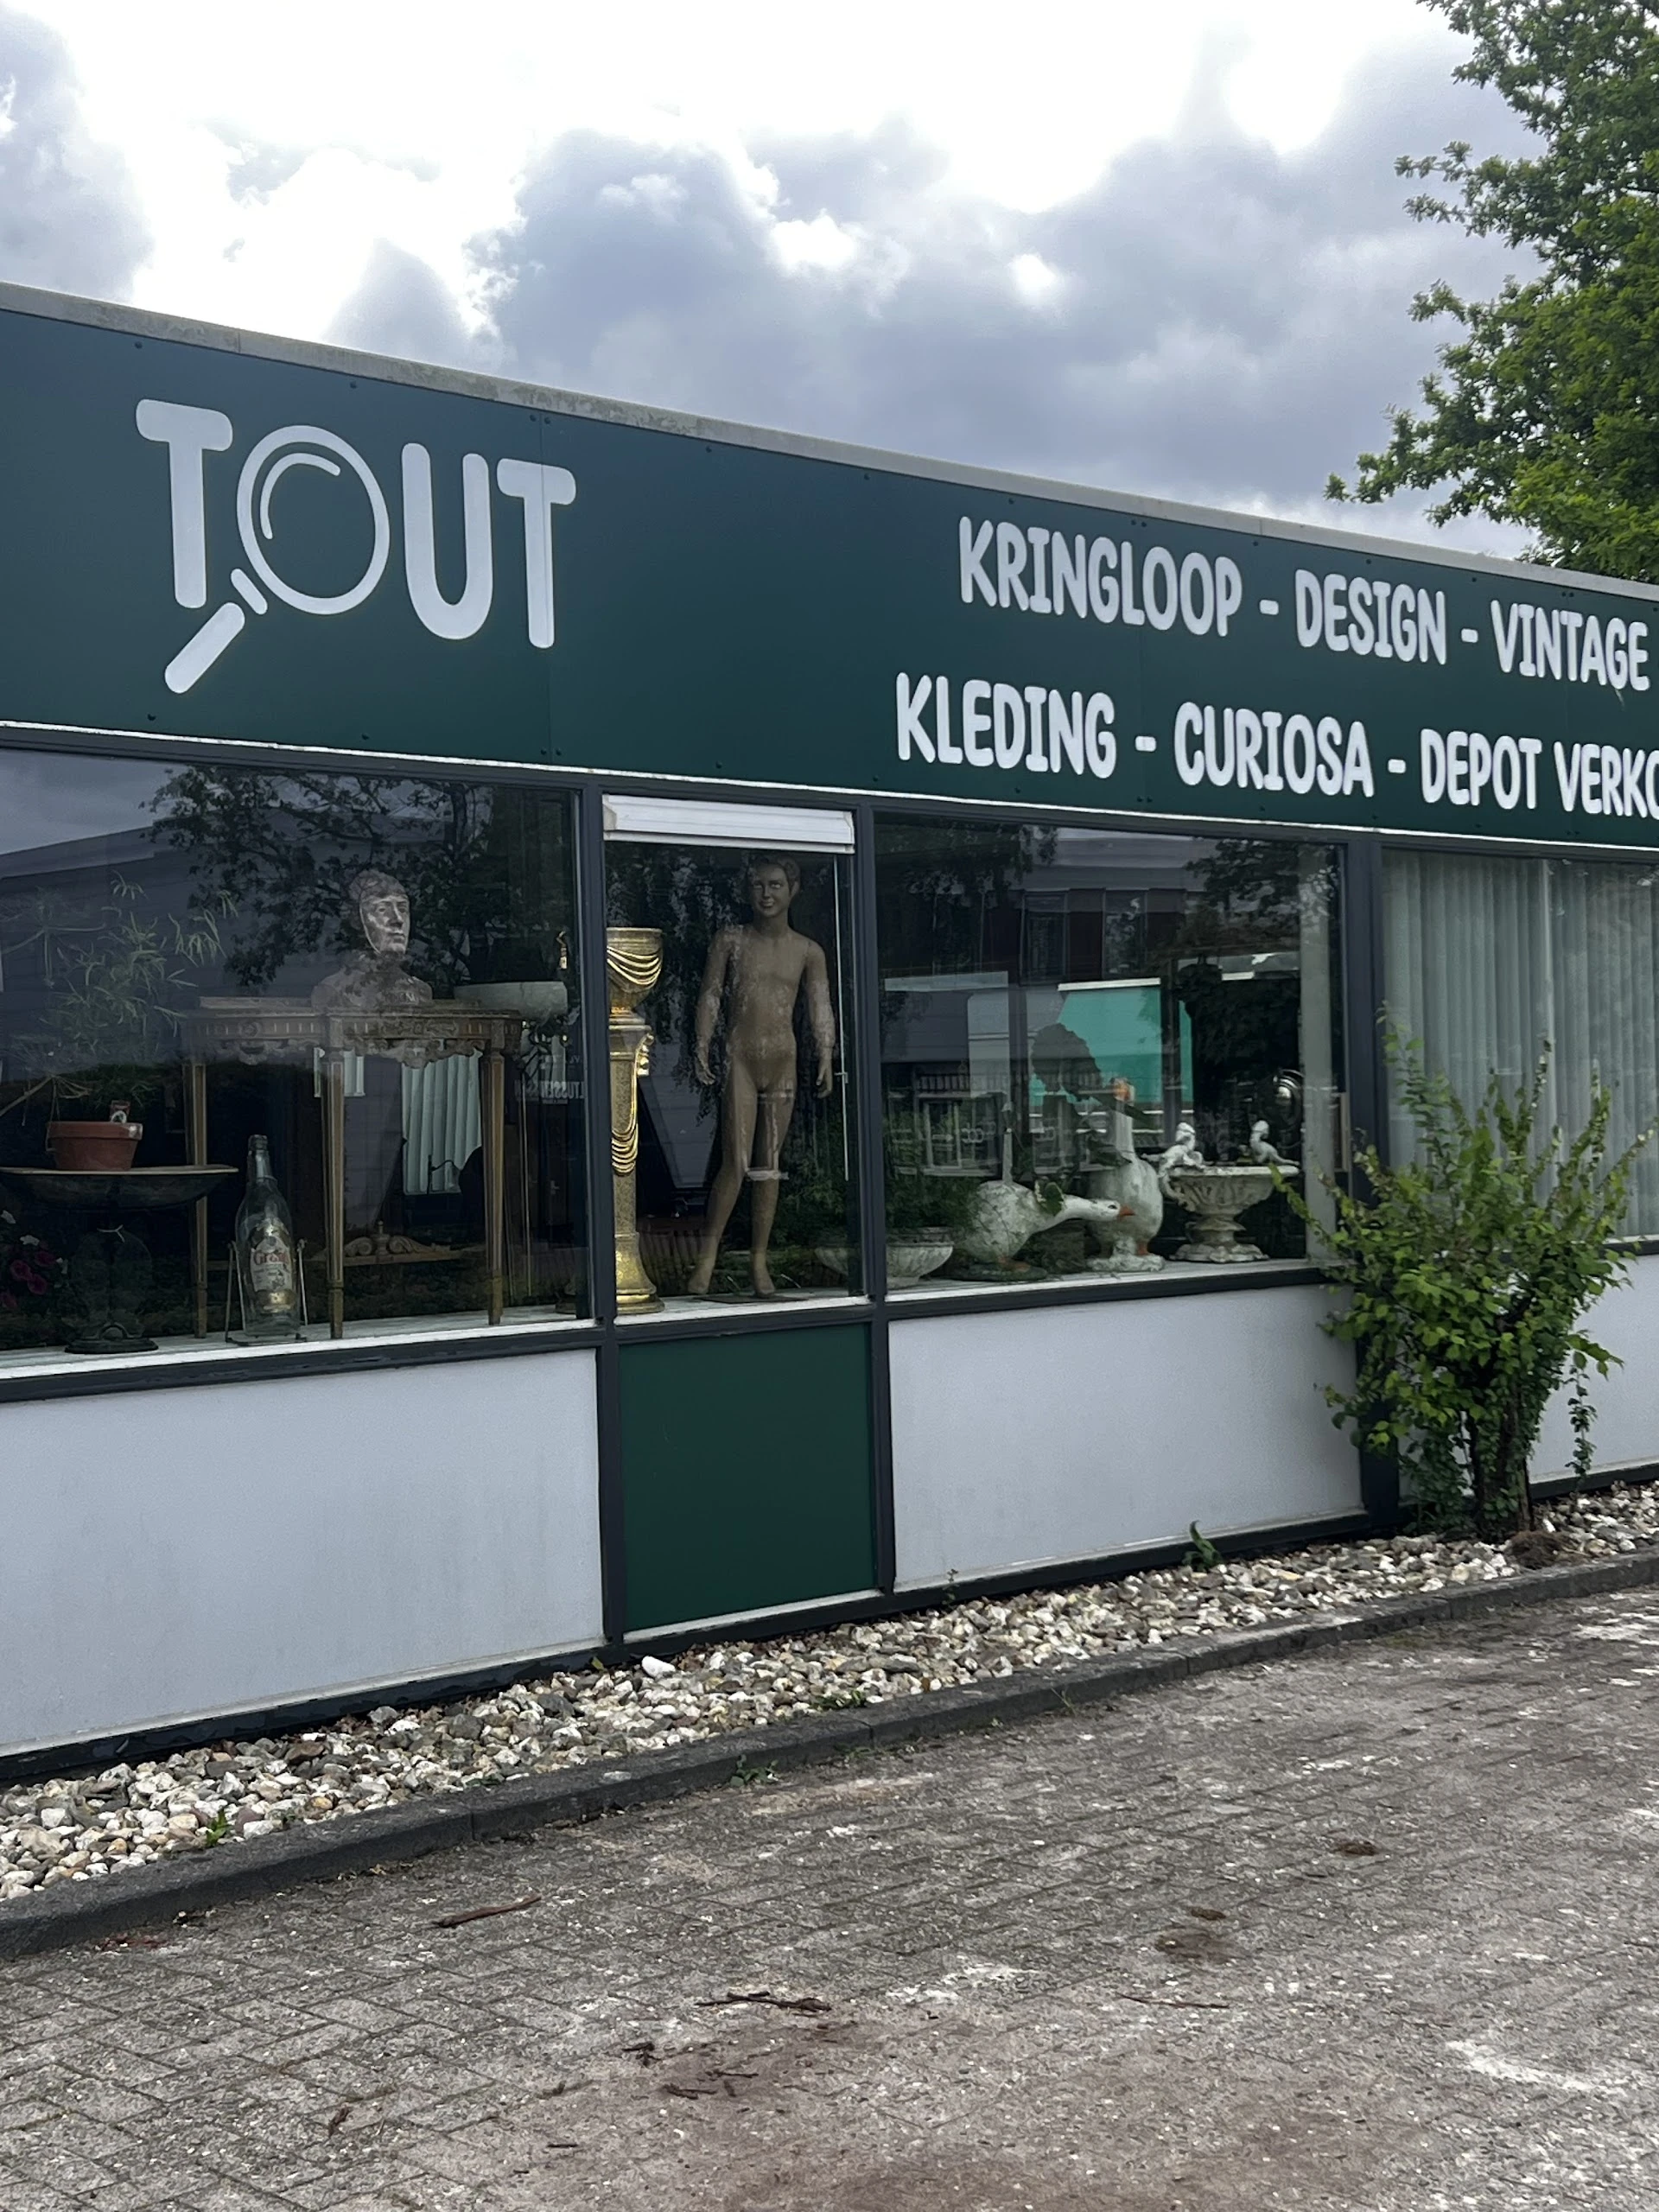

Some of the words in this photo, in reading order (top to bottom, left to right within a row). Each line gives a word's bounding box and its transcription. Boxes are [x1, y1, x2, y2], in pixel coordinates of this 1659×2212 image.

[136, 398, 576, 650] TOUT
[959, 516, 1243, 637] KRINGLOOP
[1295, 569, 1446, 665] DESIGN
[1491, 600, 1650, 691] VINTAGE
[896, 671, 1117, 779] KLEDING
[1174, 702, 1375, 798] CURIOSA
[1421, 728, 1542, 810] DEPOT
